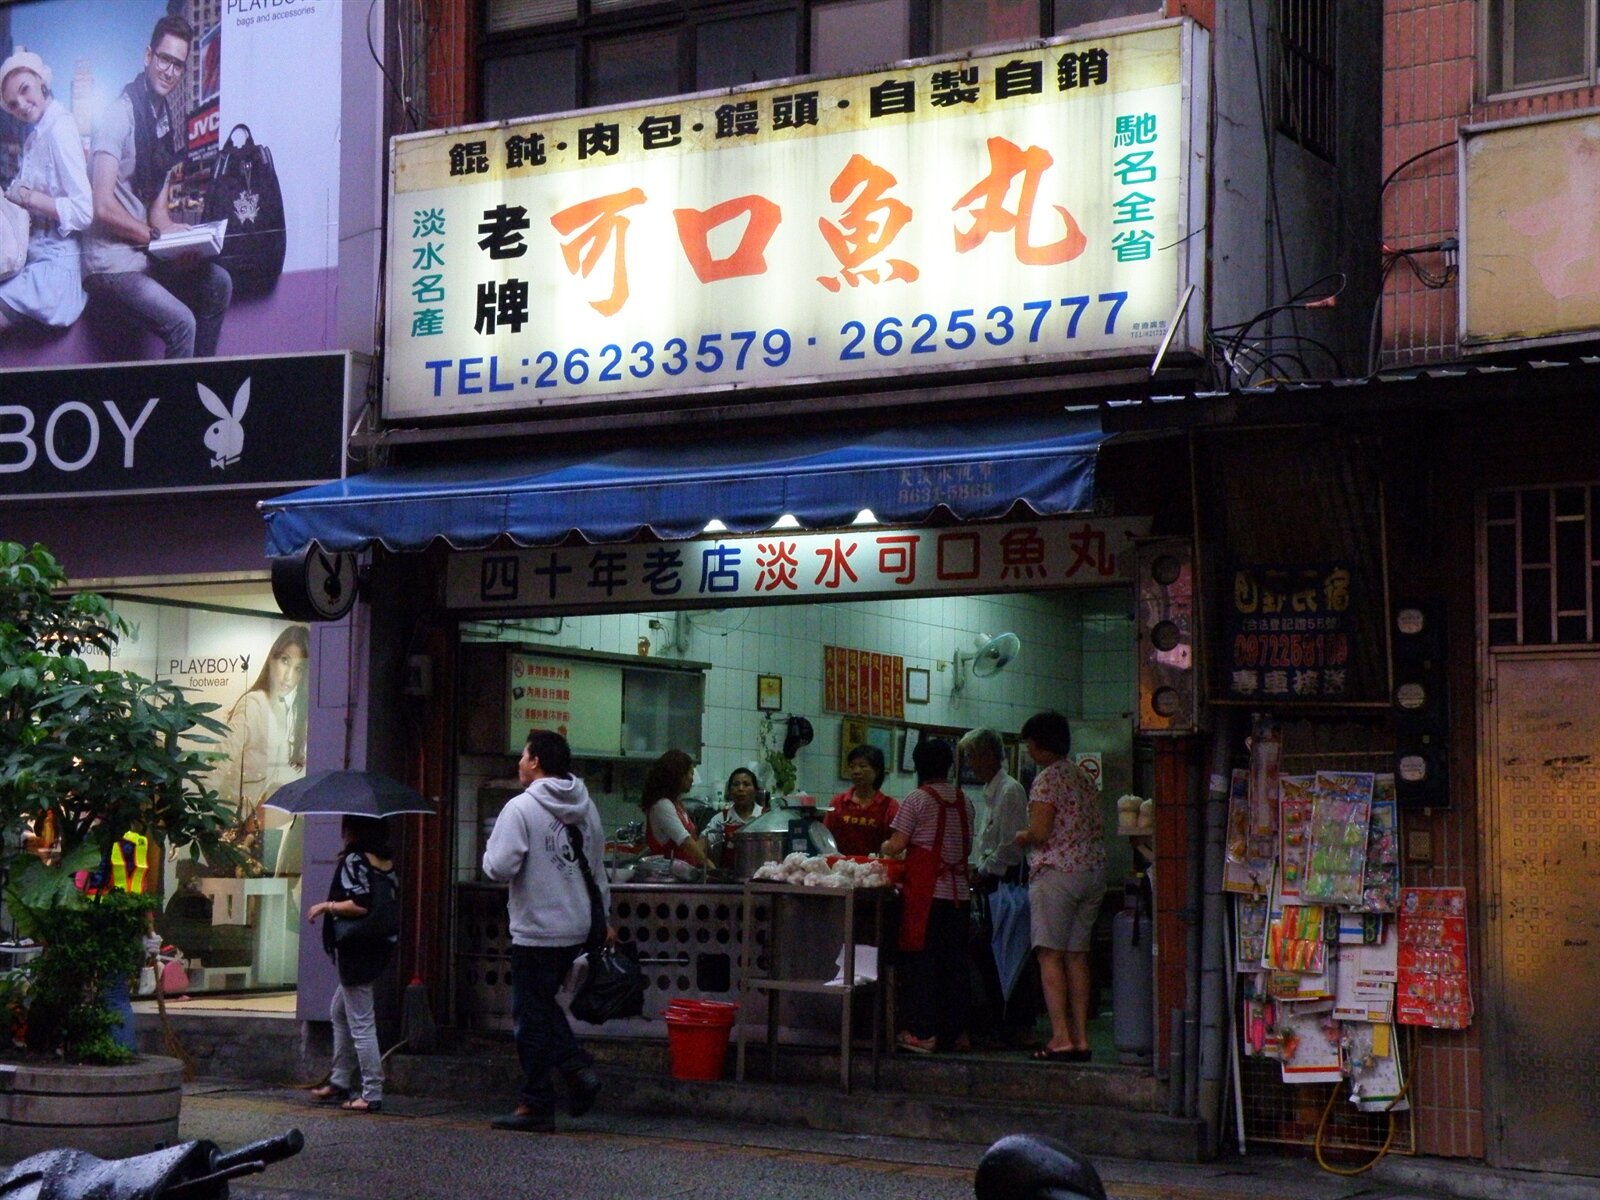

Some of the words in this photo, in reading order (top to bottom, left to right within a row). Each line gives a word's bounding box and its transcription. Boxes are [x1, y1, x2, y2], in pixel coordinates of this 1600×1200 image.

[236, 17, 255, 27] bags
[256, 14, 271, 24] and
[271, 6, 316, 21] accessories
[188, 111, 219, 140] JVC
[1111, 112, 1158, 263] 馳名全省
[550, 136, 1087, 317] 可口魚丸
[410, 207, 446, 338] 淡水名產
[474, 203, 531, 336] 老牌
[839, 291, 1129, 361] 26253777
[0, 398, 160, 473] BOY
[169, 658, 239, 675] PLAYBOY
[189, 676, 229, 687] footwear
